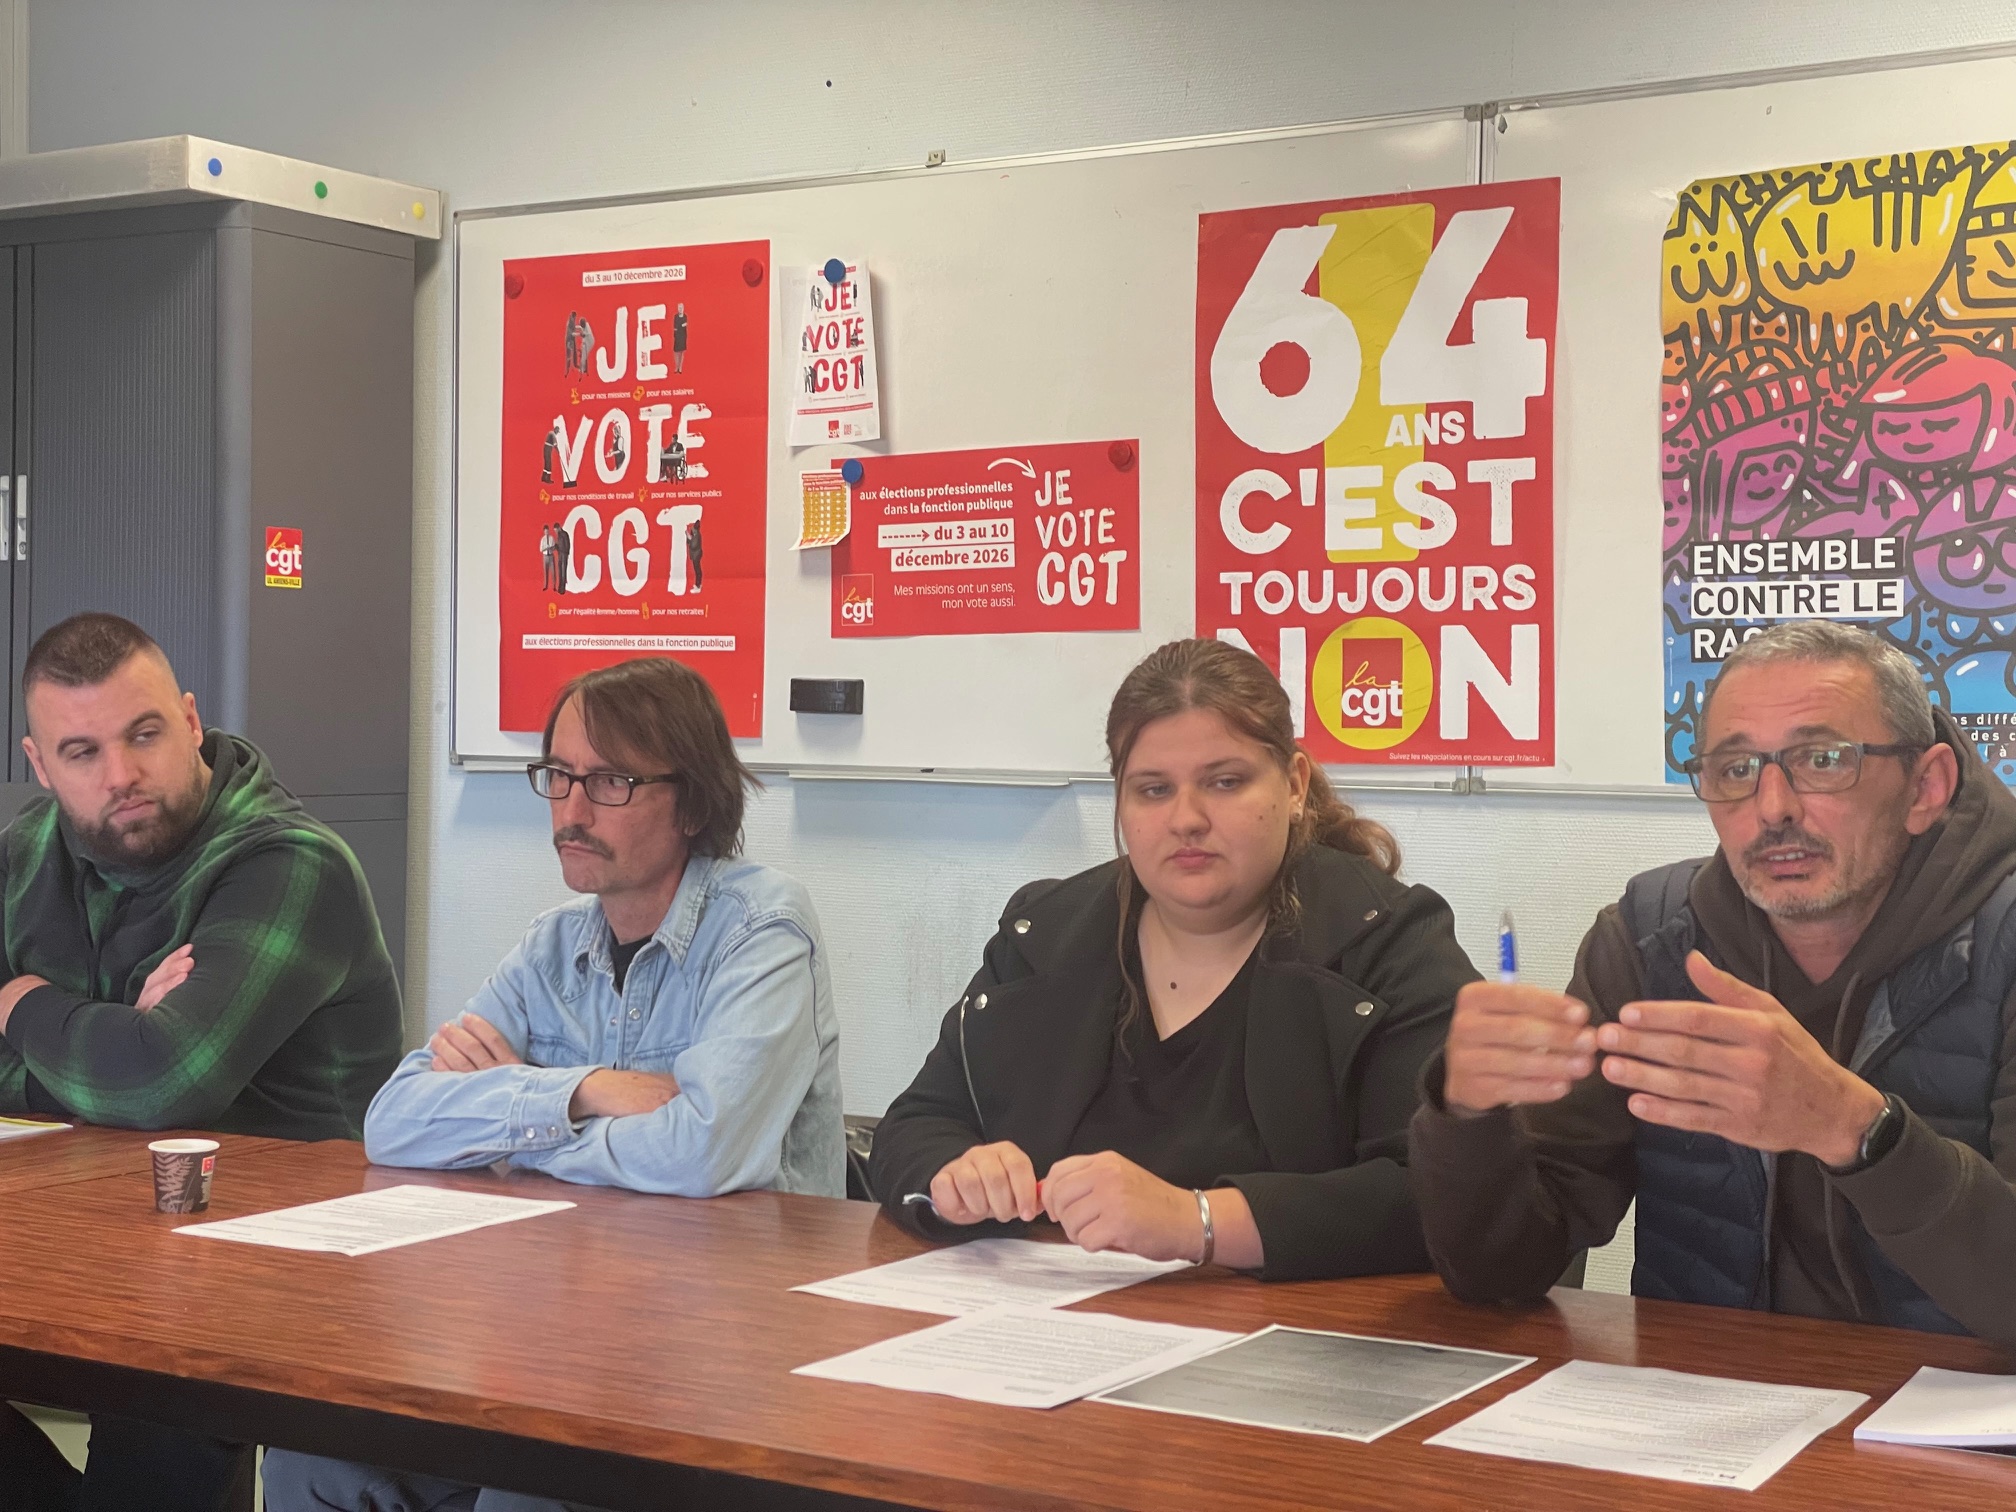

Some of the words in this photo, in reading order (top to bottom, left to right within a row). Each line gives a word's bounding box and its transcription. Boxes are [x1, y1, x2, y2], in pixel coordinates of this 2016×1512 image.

[584, 274, 594, 283] du
[596, 274, 600, 282] 3
[602, 274, 612, 282] au
[614, 272, 622, 281] 10
[624, 270, 662, 280] décembre
[664, 268, 684, 278] 2026
[825, 281, 851, 311] JE
[596, 304, 668, 383] JE
[806, 317, 864, 352] VOTE
[1210, 206, 1547, 454] 64
[813, 355, 864, 393] CGT
[553, 403, 712, 484] VOTE
[1384, 410, 1466, 447] ANS
[859, 491, 877, 500] aux
[880, 486, 926, 500] élections
[927, 481, 1014, 498] professionnelles
[1035, 469, 1073, 507] JE
[884, 504, 908, 515] dans
[910, 502, 920, 514] la
[922, 500, 965, 513] fonction
[966, 497, 1014, 512] publique
[1219, 457, 1536, 554] C'EST
[934, 526, 952, 540] du
[956, 526, 965, 540] 3
[970, 526, 987, 539] au
[991, 523, 1009, 538] 10
[1035, 508, 1116, 550] VOTE
[266, 544, 302, 575] cgt
[562, 504, 703, 596] CGT
[895, 549, 970, 567] décembre
[973, 549, 1009, 564] 2026
[1693, 538, 1896, 576] ENSEMBLE
[894, 585, 914, 596] Mes
[916, 584, 954, 595] missions
[957, 584, 974, 594] ont
[976, 583, 989, 593] un
[992, 582, 1016, 594] sens,
[1037, 550, 1127, 606] CGT
[1219, 564, 1537, 615] TOUJOURS
[842, 598, 874, 624] cgt
[942, 600, 964, 609] mon
[966, 598, 988, 608] vote
[990, 595, 1016, 607] aussi.
[1693, 583, 1840, 616] CONTRE
[1853, 582, 1898, 612] LE
[524, 638, 538, 646] aux
[539, 637, 572, 646] élections
[574, 638, 636, 647] professionnelles
[637, 638, 656, 647] dans
[657, 638, 664, 646] la
[666, 638, 698, 647] fonction
[700, 638, 734, 648] publique
[1345, 660, 1391, 688] la
[1342, 680, 1404, 726] cgt
[1971, 730, 2000, 742] des
[1999, 744, 2007, 758] à
[1422, 753, 1462, 762] négociations
